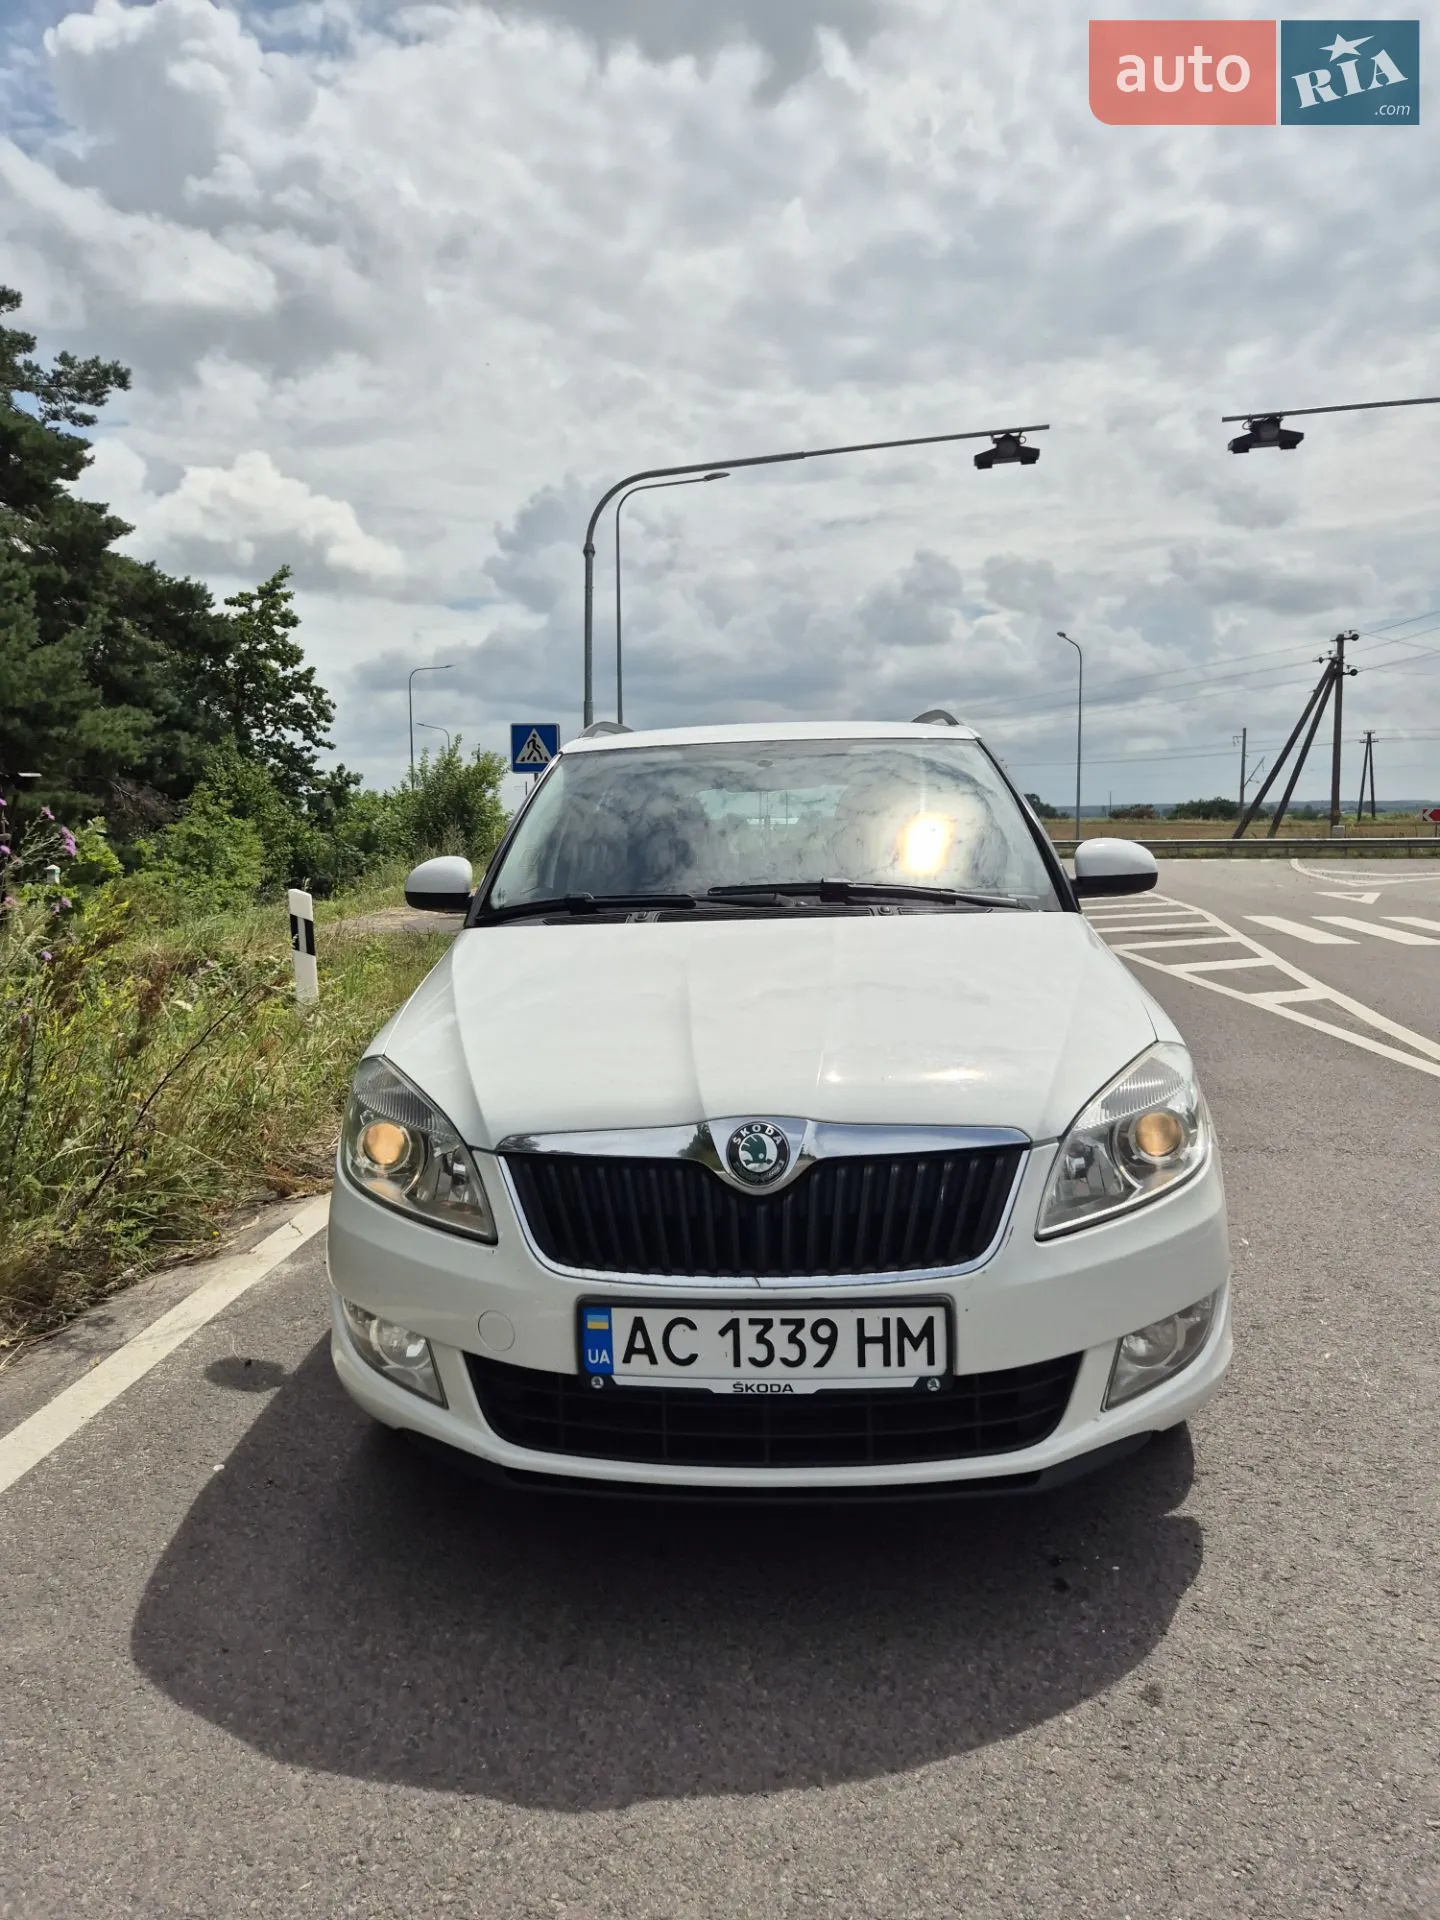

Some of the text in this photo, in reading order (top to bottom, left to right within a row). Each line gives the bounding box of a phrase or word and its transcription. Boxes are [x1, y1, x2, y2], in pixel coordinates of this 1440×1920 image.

[588, 1349, 611, 1365] UA
[622, 1316, 935, 1368] AC 1339 HM
